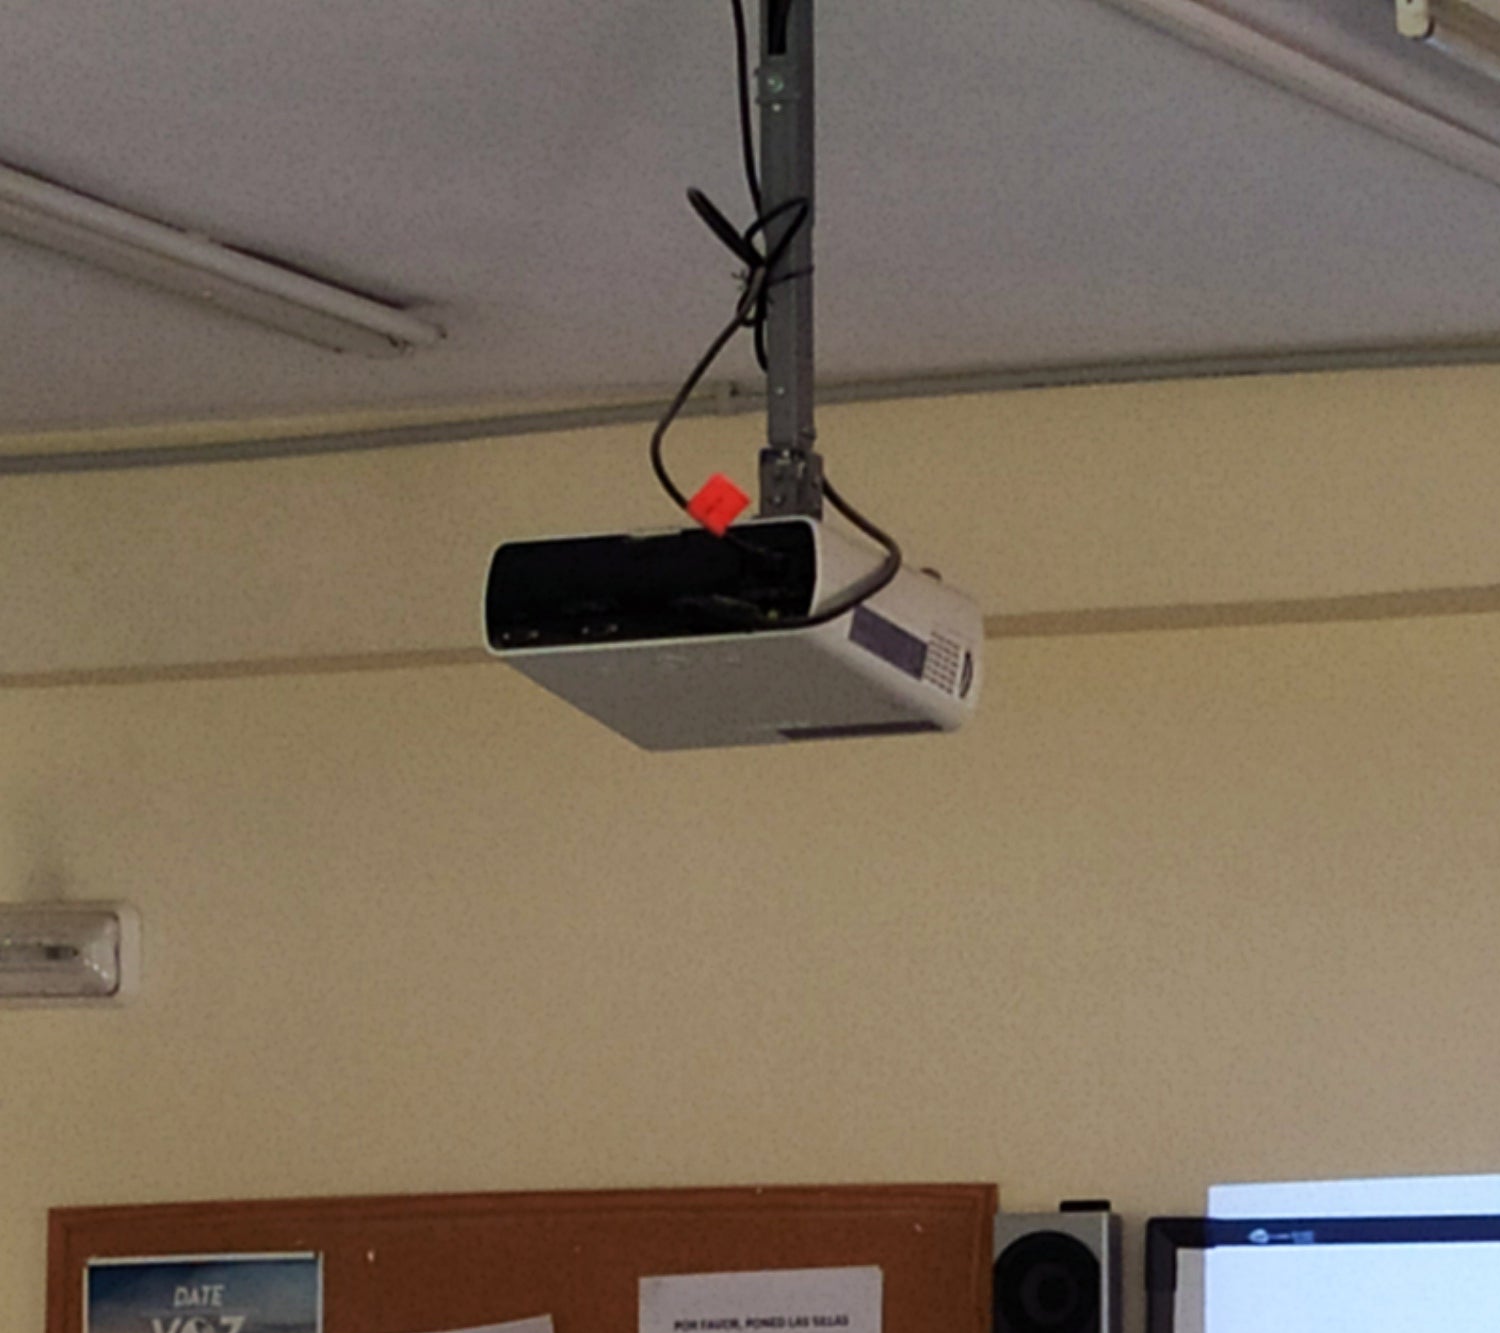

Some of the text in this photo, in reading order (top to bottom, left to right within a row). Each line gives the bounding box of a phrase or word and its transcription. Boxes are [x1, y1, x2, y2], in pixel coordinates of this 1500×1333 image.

[173, 1284, 225, 1308] DATE
[673, 1318, 698, 1332] POR
[788, 1315, 810, 1328] LAS
